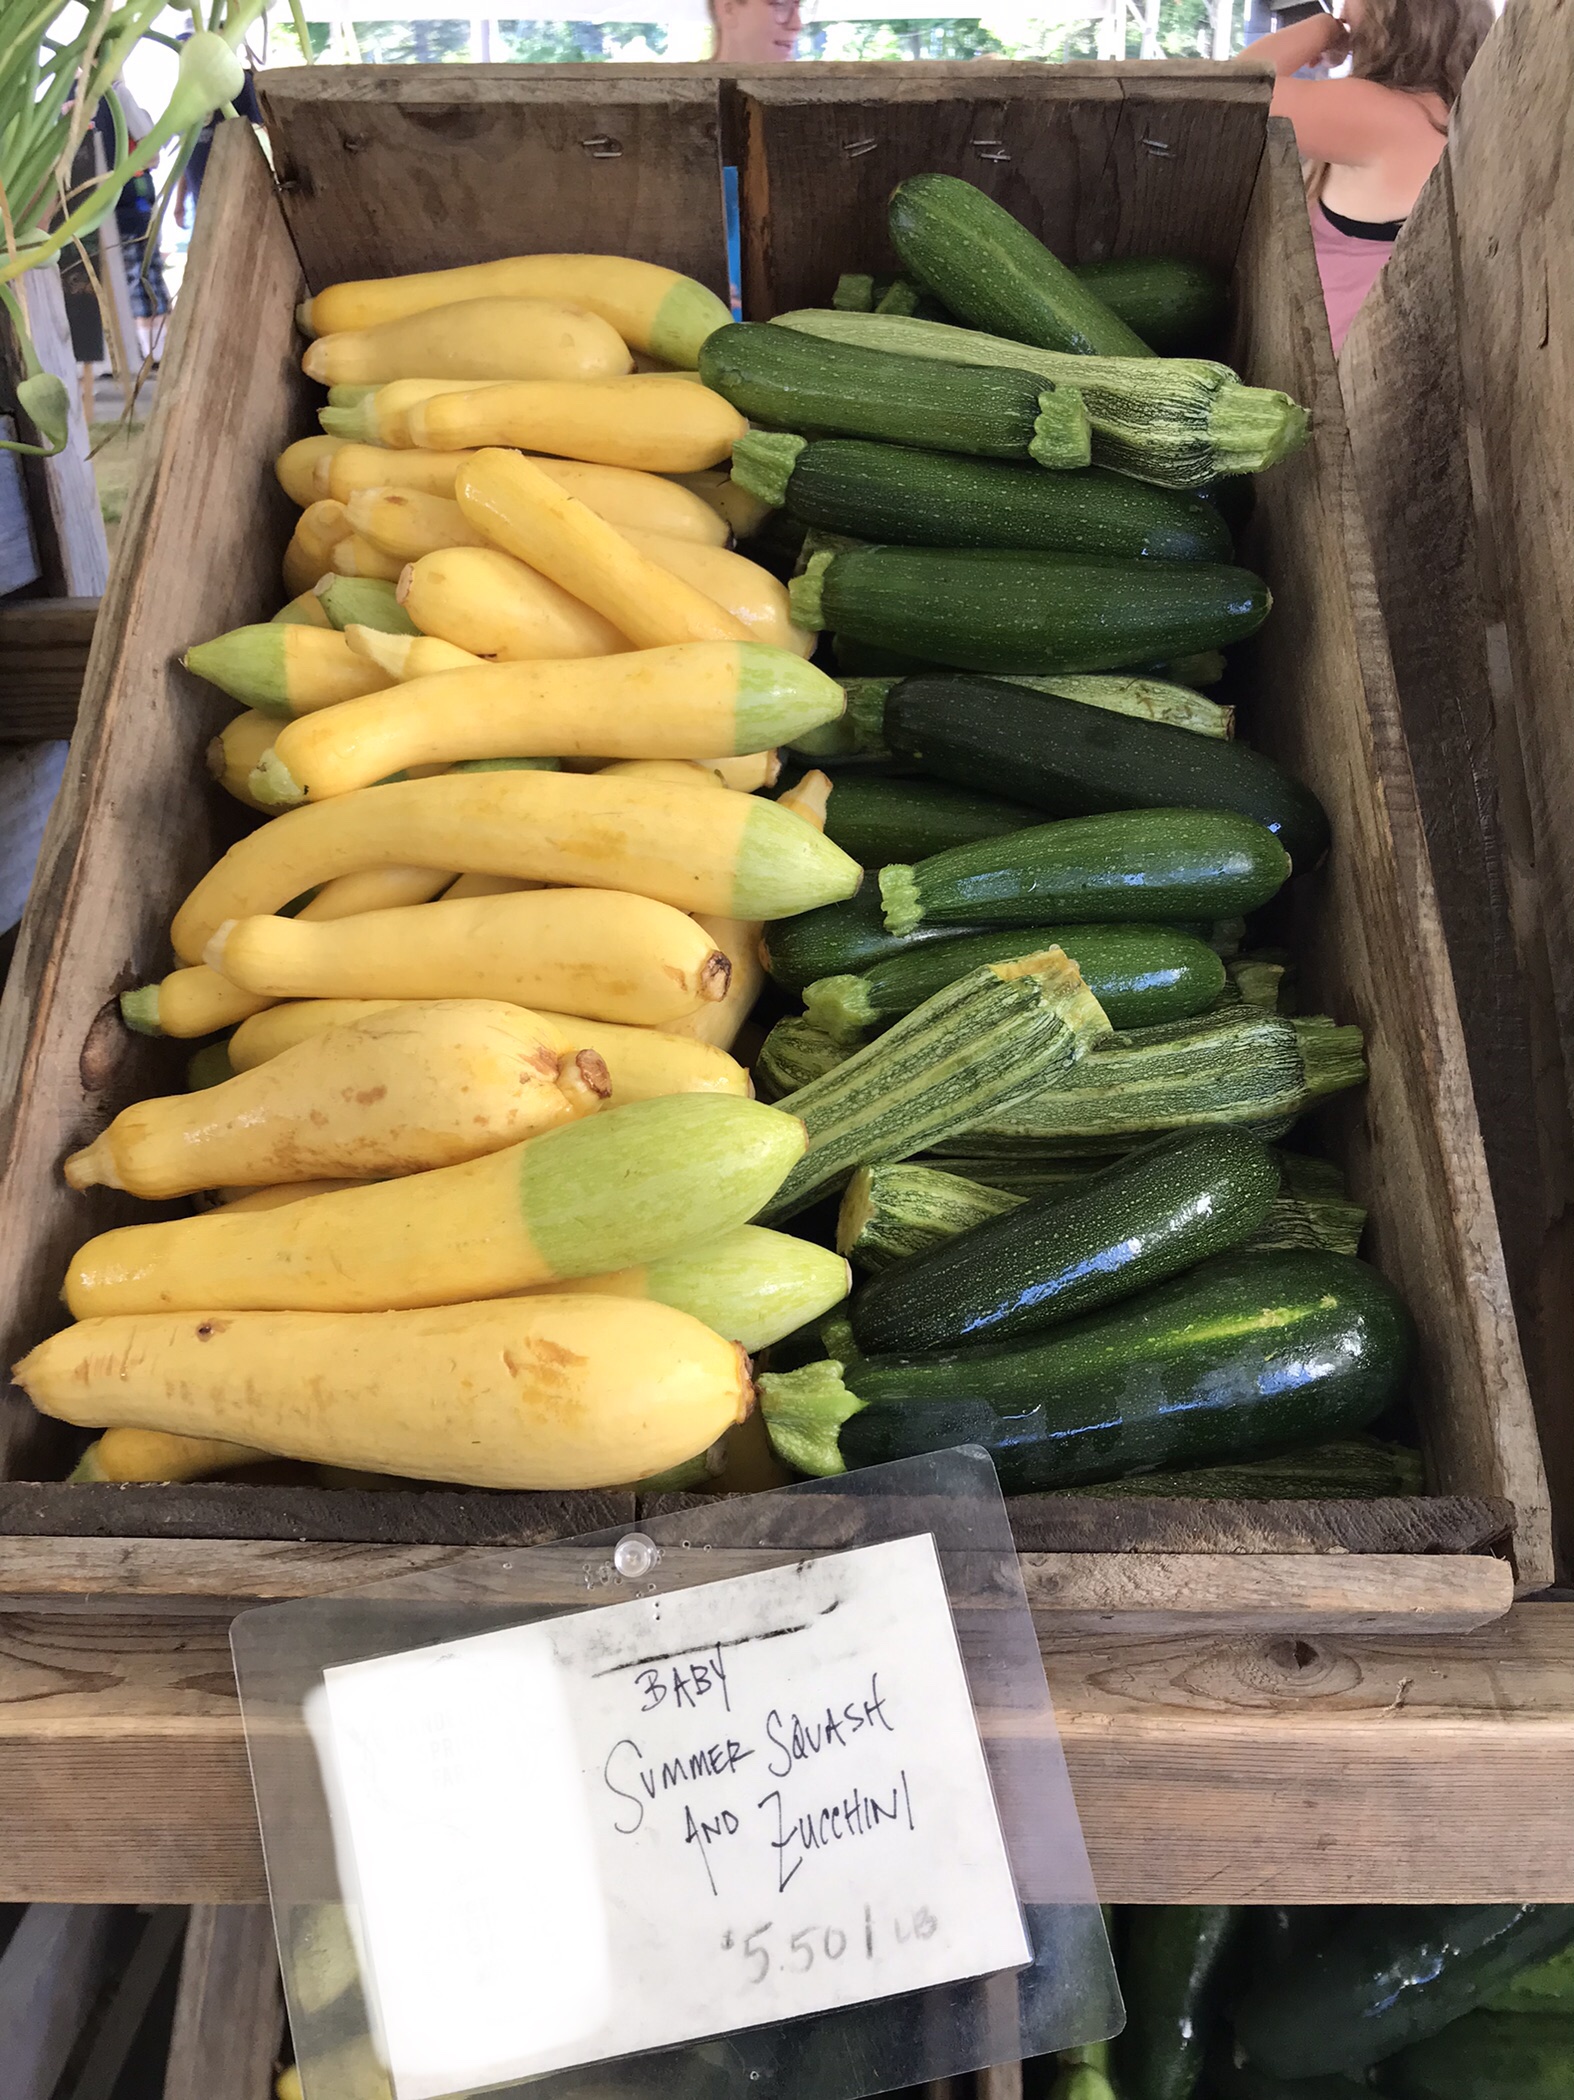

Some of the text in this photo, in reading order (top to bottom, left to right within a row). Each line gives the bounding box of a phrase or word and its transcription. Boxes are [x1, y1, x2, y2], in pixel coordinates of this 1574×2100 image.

[635, 1641, 732, 1712] BABY
[604, 1739, 755, 1834] SUMMER
[766, 1672, 895, 1778] SQUASH
[685, 1769, 915, 1896] AND ZUCCHINI
